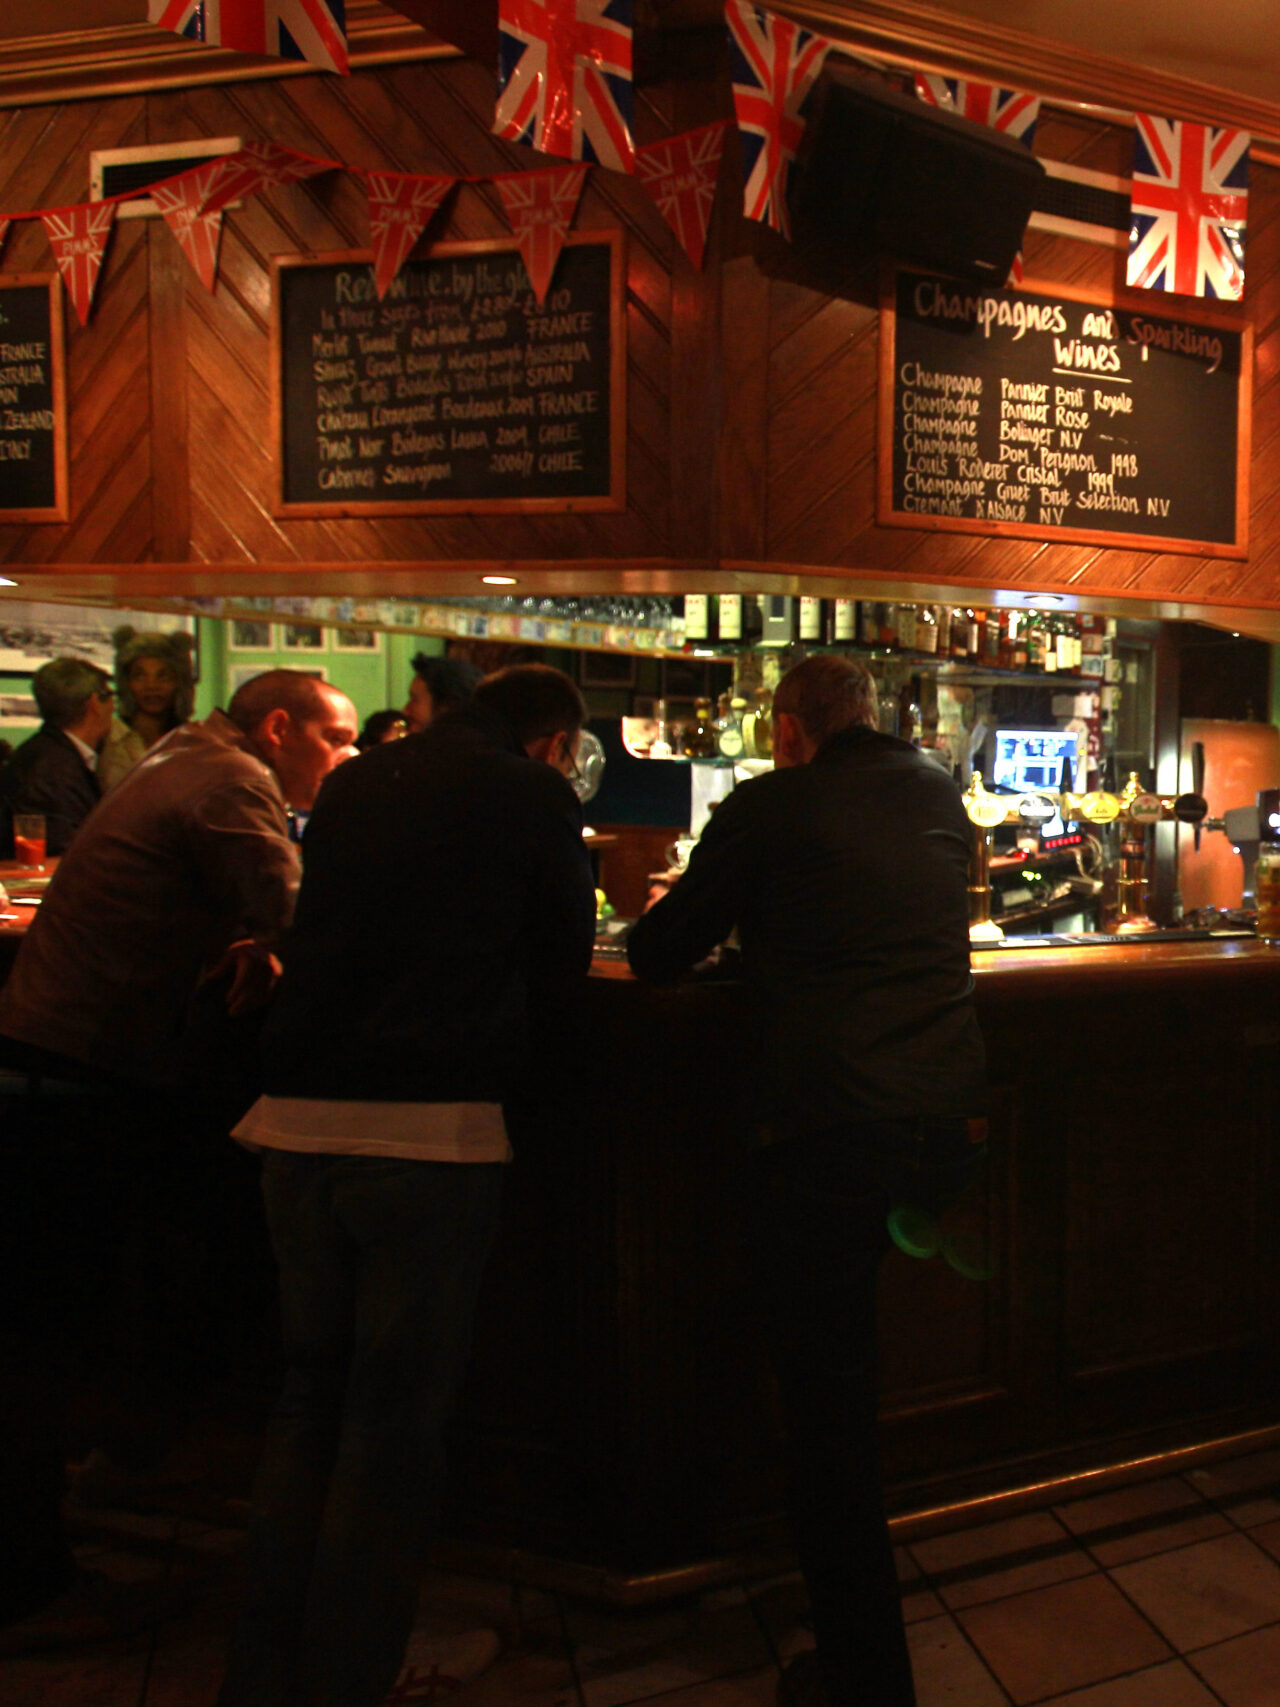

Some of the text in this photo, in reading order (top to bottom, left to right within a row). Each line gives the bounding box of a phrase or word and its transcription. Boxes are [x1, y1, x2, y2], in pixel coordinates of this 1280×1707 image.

[526, 312, 592, 340] FRANCE
[914, 281, 1224, 374] Champagnes and Sparkling
[1053, 338, 1121, 373] Wines
[526, 362, 574, 388] SPAIN
[901, 362, 1134, 418] Champagne Pannier Brut Royale
[538, 389, 600, 416] FRANCE
[903, 391, 1091, 430] Champagne Pannier Rose
[903, 413, 978, 441] Champagne
[903, 432, 978, 462] Champagne
[1040, 446, 1098, 476] Perignon
[1111, 453, 1139, 478] 1998
[1017, 463, 1062, 487] Cristal
[903, 472, 986, 501] Champagne
[1040, 487, 1072, 507] Brut
[1076, 490, 1141, 514] Selection
